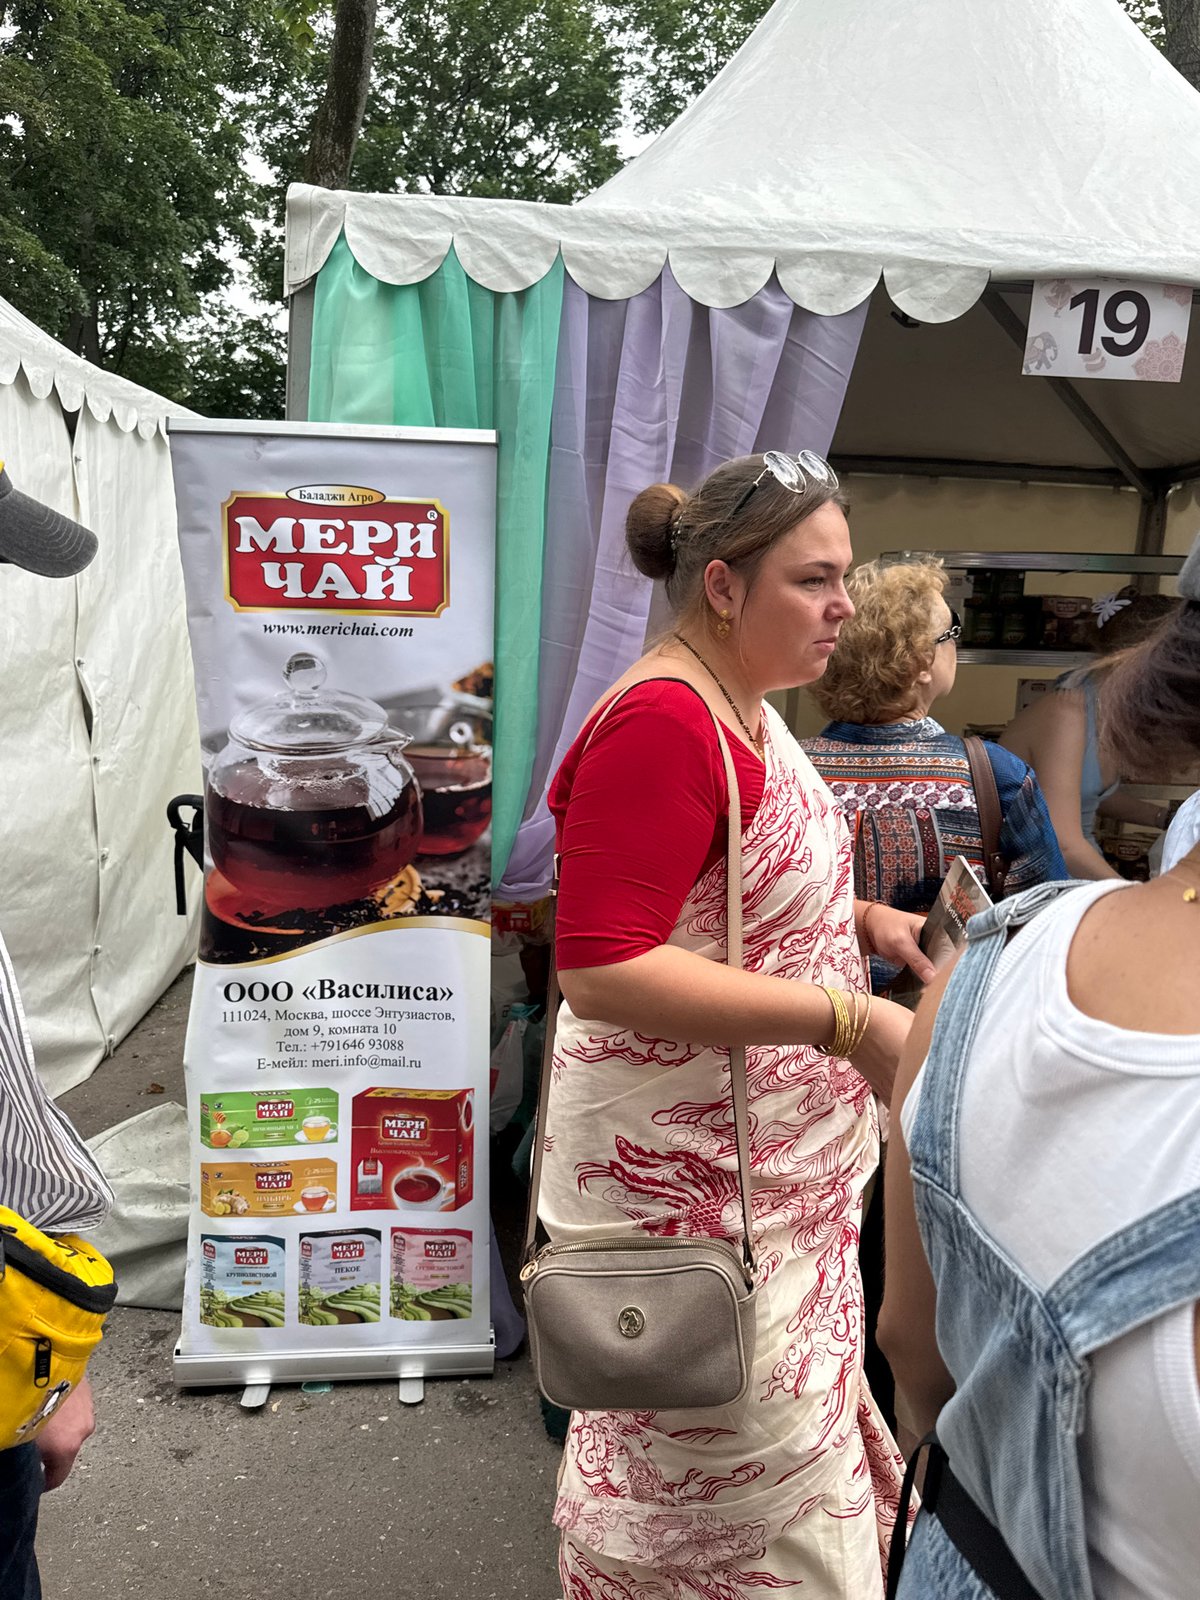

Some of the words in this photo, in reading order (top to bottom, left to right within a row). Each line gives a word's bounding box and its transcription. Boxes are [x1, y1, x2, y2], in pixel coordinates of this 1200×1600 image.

[1069, 289, 1151, 357] 19
[298, 489, 346, 502] Баладжи
[348, 491, 374, 503] Агро
[234, 516, 437, 559] МЕРИ
[260, 554, 415, 602] ЧАЙ
[262, 622, 414, 638] www.merichai.com
[223, 980, 294, 1003] ООО
[302, 979, 454, 1002] «Василиса»
[222, 1011, 271, 1023] 111024,
[274, 1009, 328, 1021] Москва,
[332, 1008, 371, 1019] шоссе
[374, 1006, 455, 1022] Энтузиастов,
[284, 1027, 309, 1038] дом
[313, 1025, 324, 1038] 9,
[328, 1024, 379, 1035] комната
[382, 1023, 397, 1035] 10
[276, 1040, 307, 1053] Тел.:
[310, 1040, 365, 1052] +791646
[368, 1039, 404, 1051] 93088
[311, 1054, 422, 1069] meri.info@mail.ru
[384, 1119, 425, 1130] МЕРИ
[389, 1128, 421, 1139] ЧАЙ
[335, 1266, 361, 1274] ПЕКОЕ
